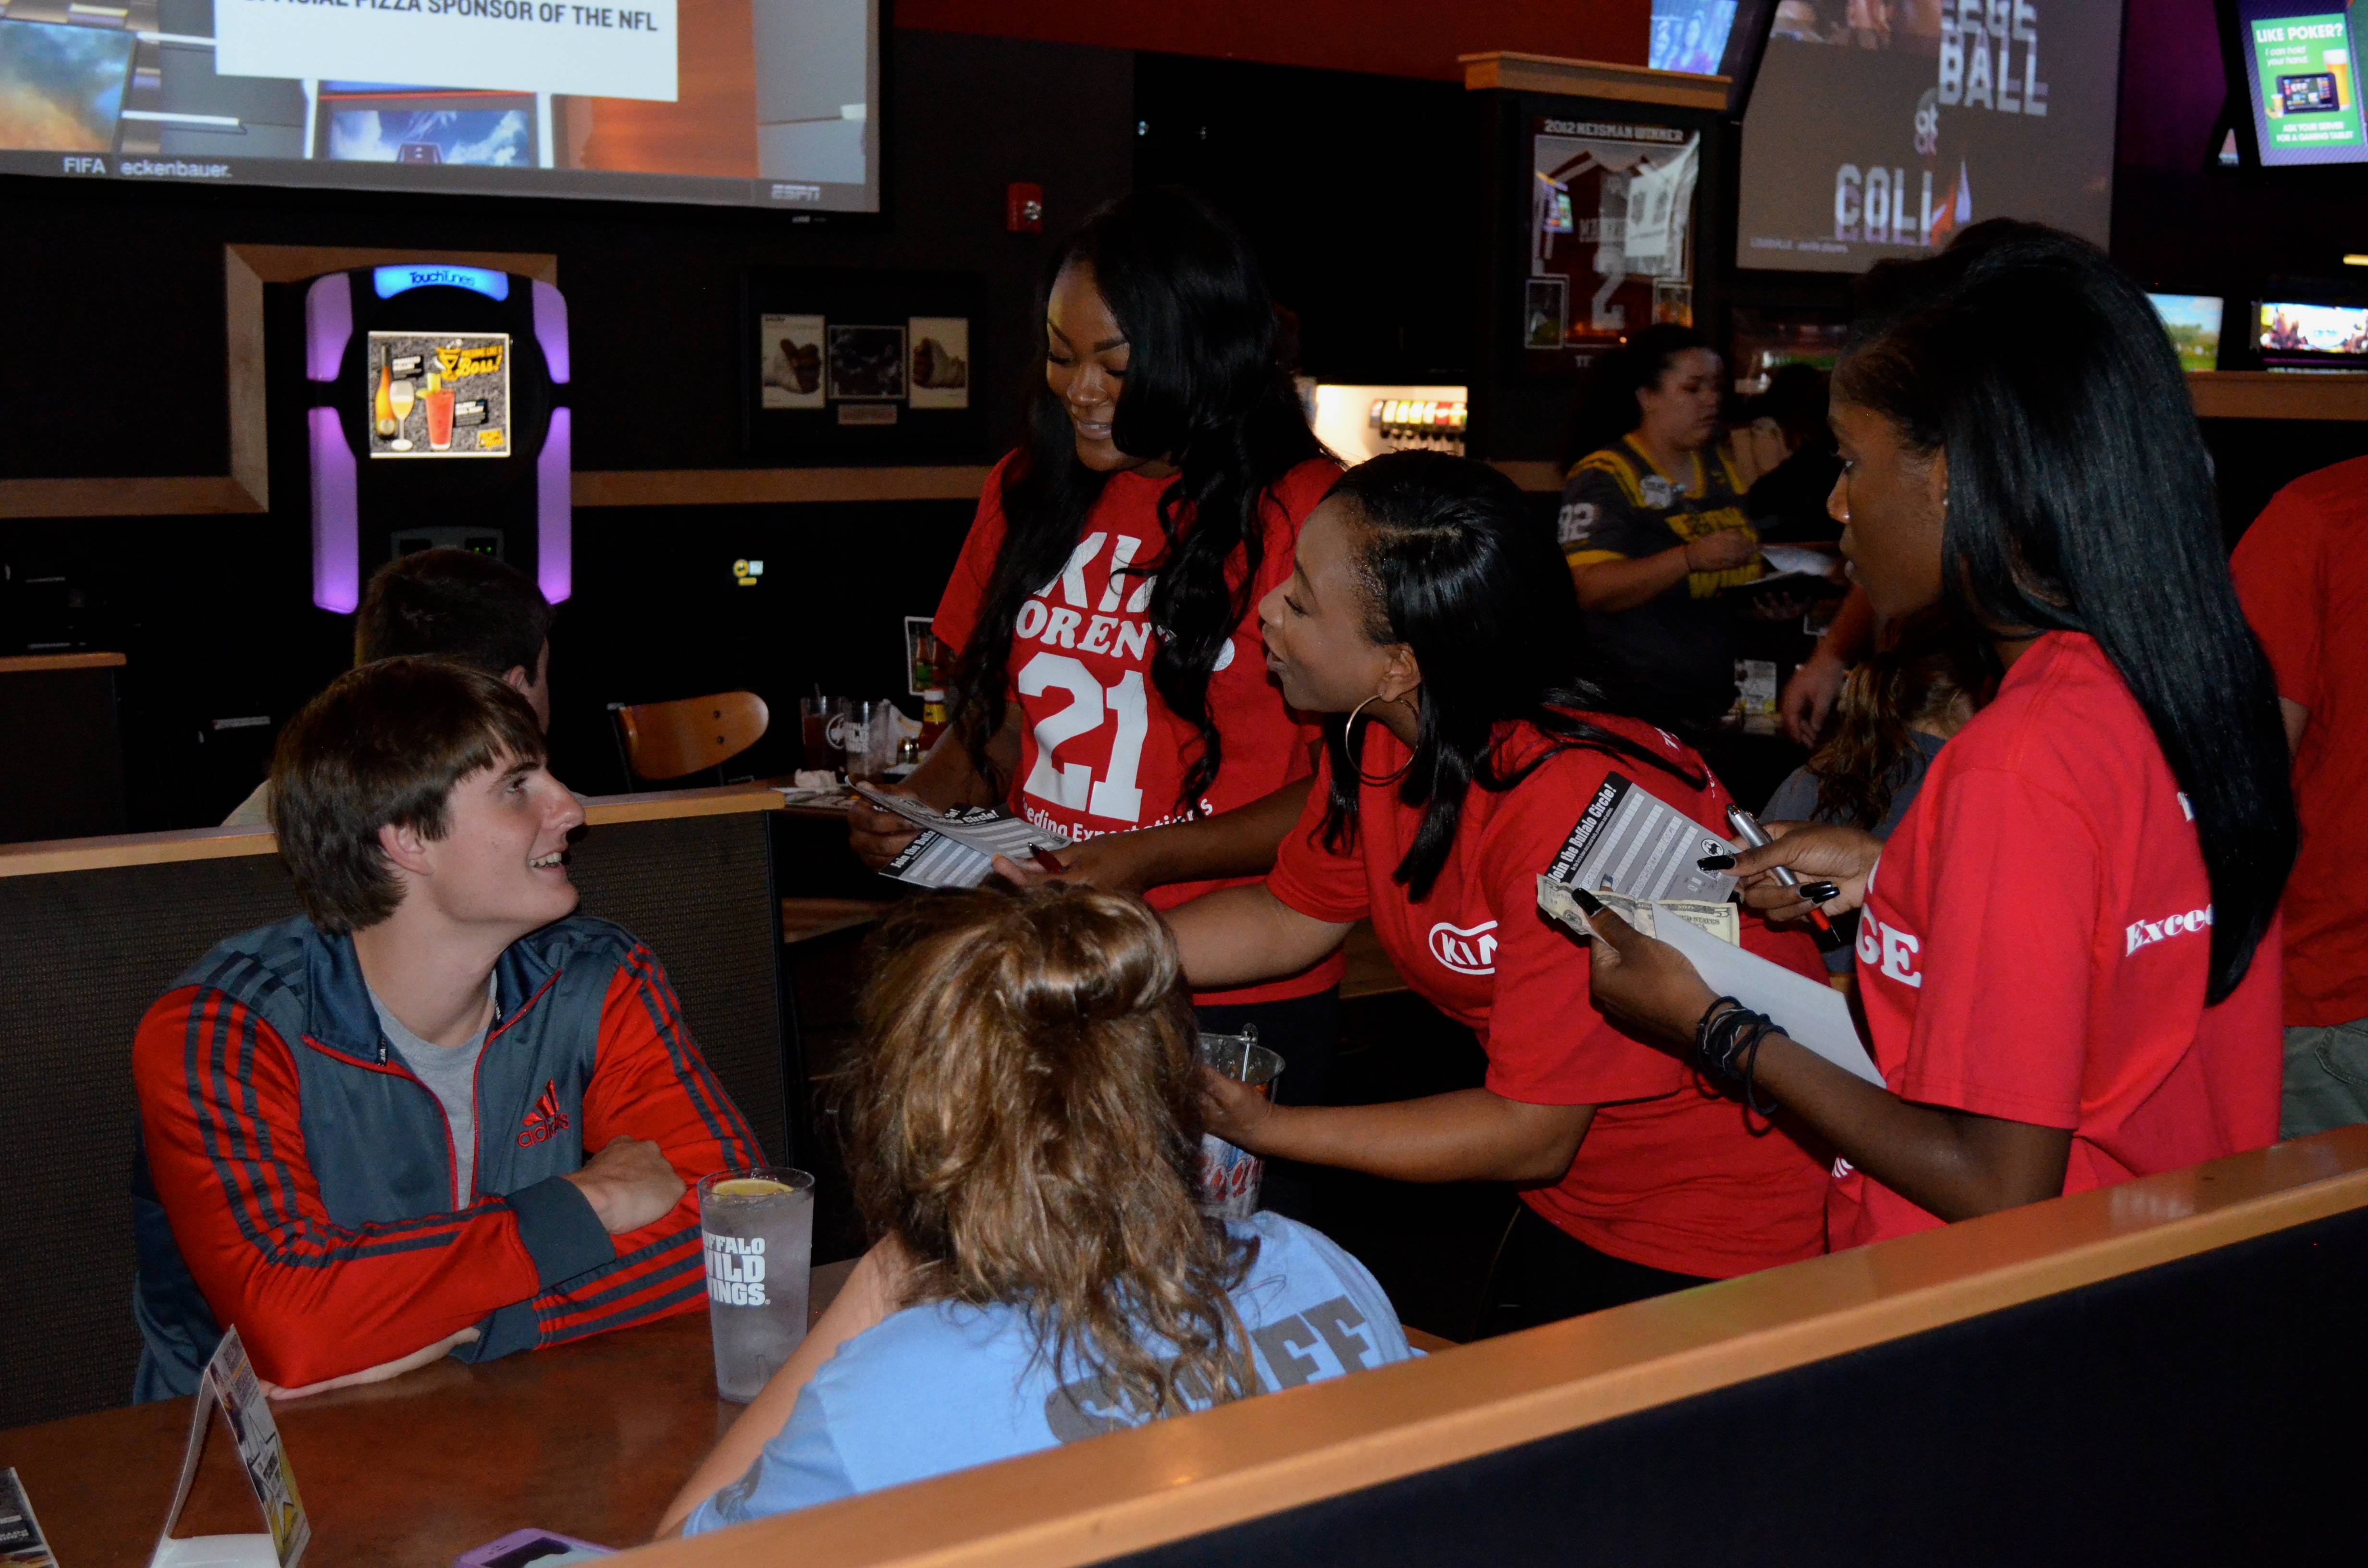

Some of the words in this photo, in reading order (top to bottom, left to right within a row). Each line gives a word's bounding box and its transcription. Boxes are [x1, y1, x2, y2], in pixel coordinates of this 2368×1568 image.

[428, 0, 533, 21] SPONSOR
[540, 3, 567, 23] OF
[572, 6, 613, 27] THE
[618, 11, 657, 31] NFL
[2256, 27, 2285, 43] LIKE
[2287, 23, 2343, 41] POKER?
[63, 157, 106, 174] FIFA
[771, 184, 820, 201] ESPN
[410, 269, 475, 287] TouchTunes
[1018, 651, 1148, 823] 21
[1588, 783, 1617, 818] Circle!
[962, 809, 999, 824] Circle!
[1568, 816, 1597, 848] Buffalo
[890, 853, 909, 869] Join
[905, 843, 919, 858] the
[914, 829, 937, 847] Buffa
[1560, 841, 1579, 863] the
[1547, 861, 1570, 883] Join
